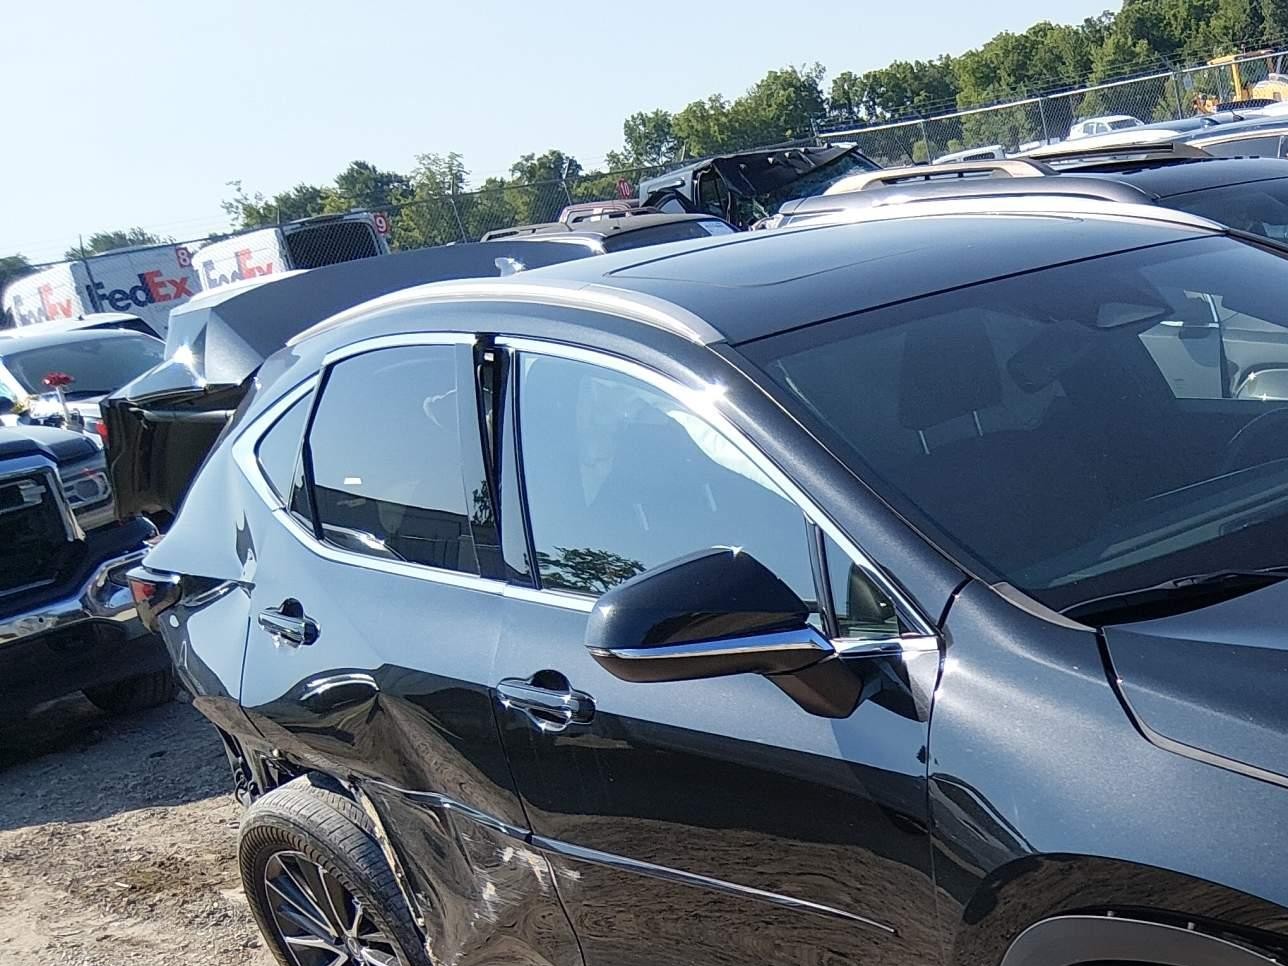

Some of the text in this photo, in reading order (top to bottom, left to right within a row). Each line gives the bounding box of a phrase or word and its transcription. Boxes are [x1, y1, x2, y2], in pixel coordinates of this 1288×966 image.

[374, 214, 388, 234] 9
[177, 250, 191, 266] 8
[86, 269, 193, 313] FedEx
